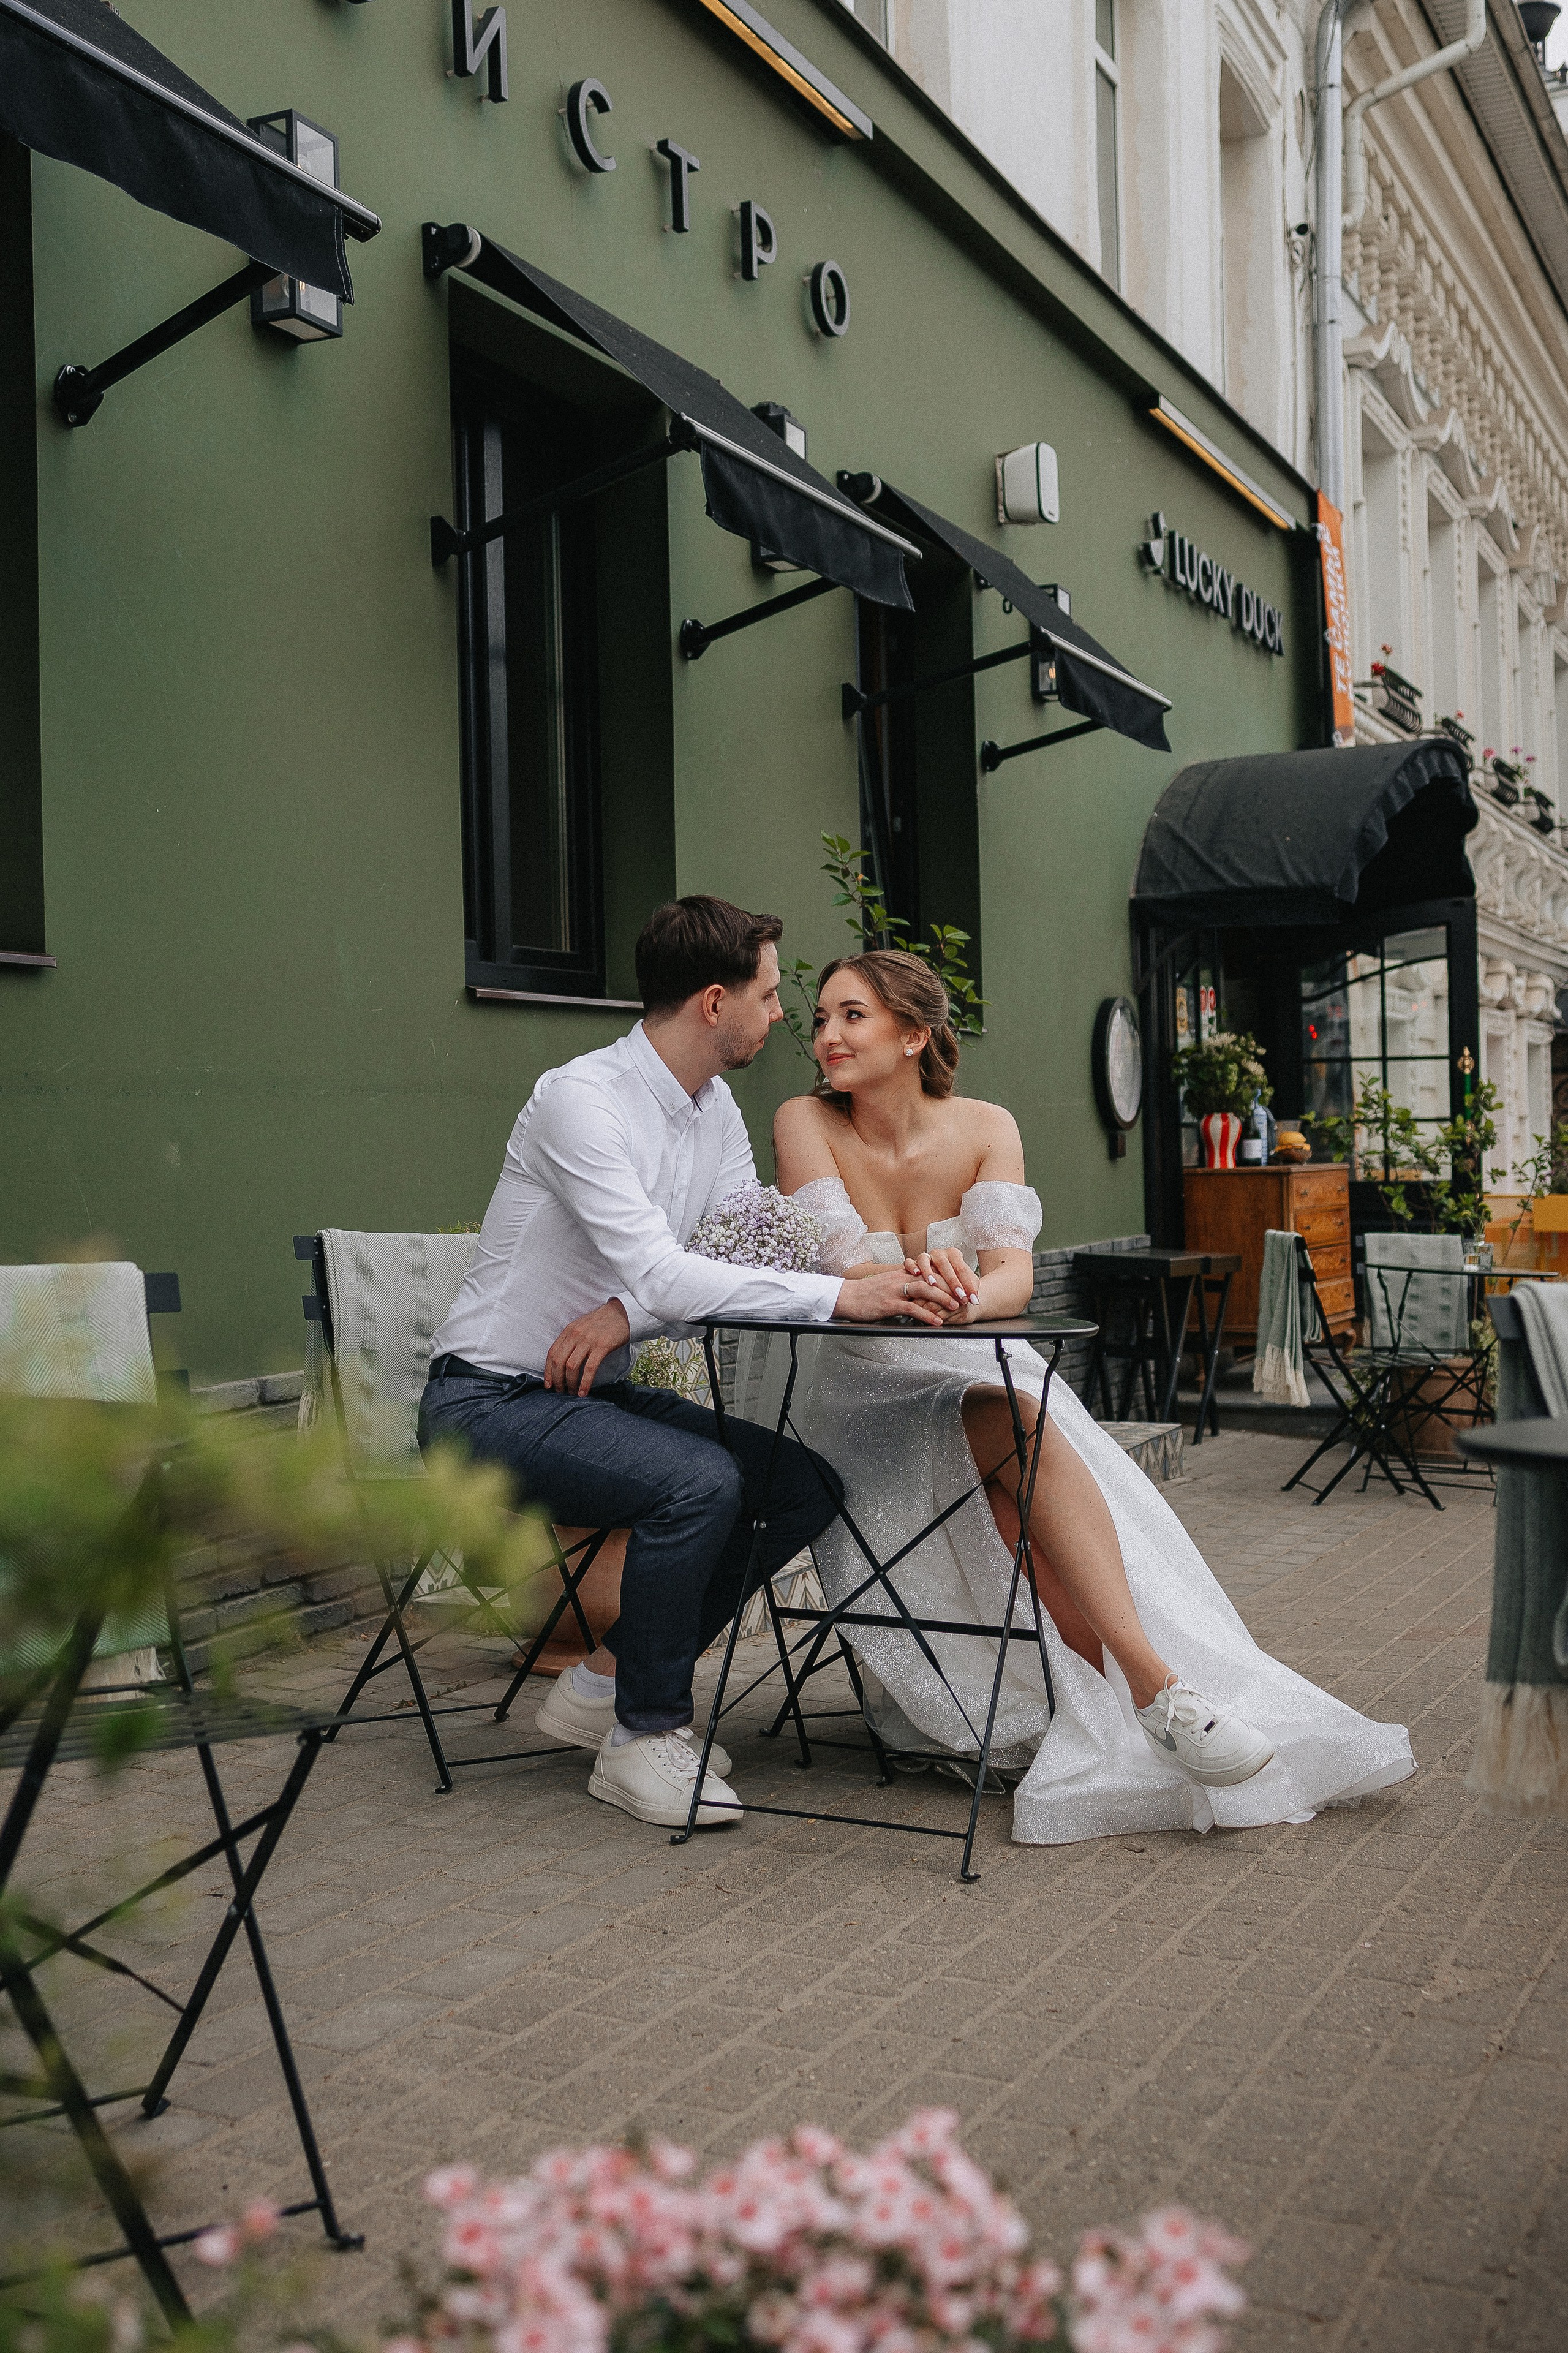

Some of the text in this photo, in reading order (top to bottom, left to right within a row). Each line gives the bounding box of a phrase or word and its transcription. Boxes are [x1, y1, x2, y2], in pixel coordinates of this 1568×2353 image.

[347, 0, 851, 338] ИСТРО
[1169, 529, 1284, 655] LUCKY DUCK
